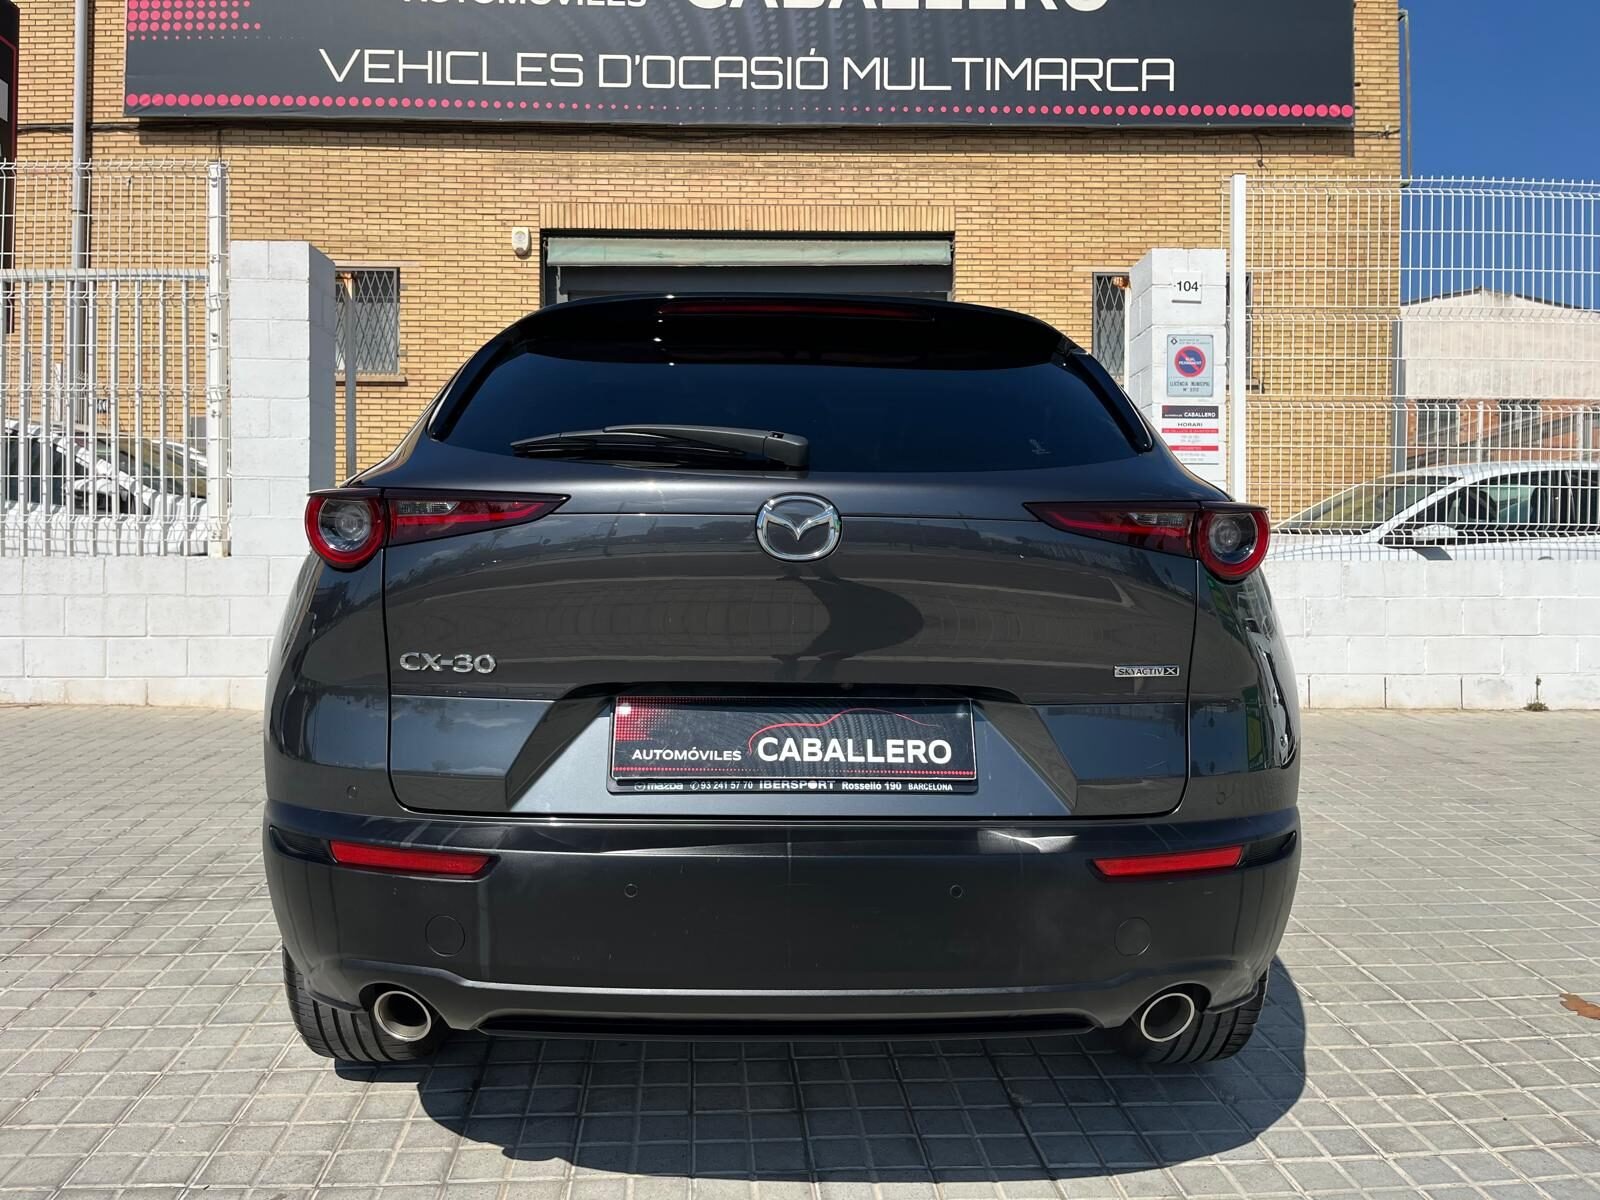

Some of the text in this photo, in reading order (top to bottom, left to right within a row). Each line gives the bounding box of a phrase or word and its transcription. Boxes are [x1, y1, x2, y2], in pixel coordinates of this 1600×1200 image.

[319, 48, 1174, 92] VEHICLES D'OCASIÓ MULTIMARCA
[1176, 280, 1199, 292] 104
[399, 651, 496, 674] CX-30
[632, 736, 952, 764] AUTOMÓVILES CABALLERO
[647, 782, 683, 790] mazda
[701, 781, 711, 790] 93
[713, 781, 728, 790] 241
[730, 781, 740, 790] 57
[743, 781, 753, 790] 70
[760, 780, 836, 790] IBERSPORT
[884, 782, 902, 791] 190
[908, 783, 953, 791] BARCELONA
